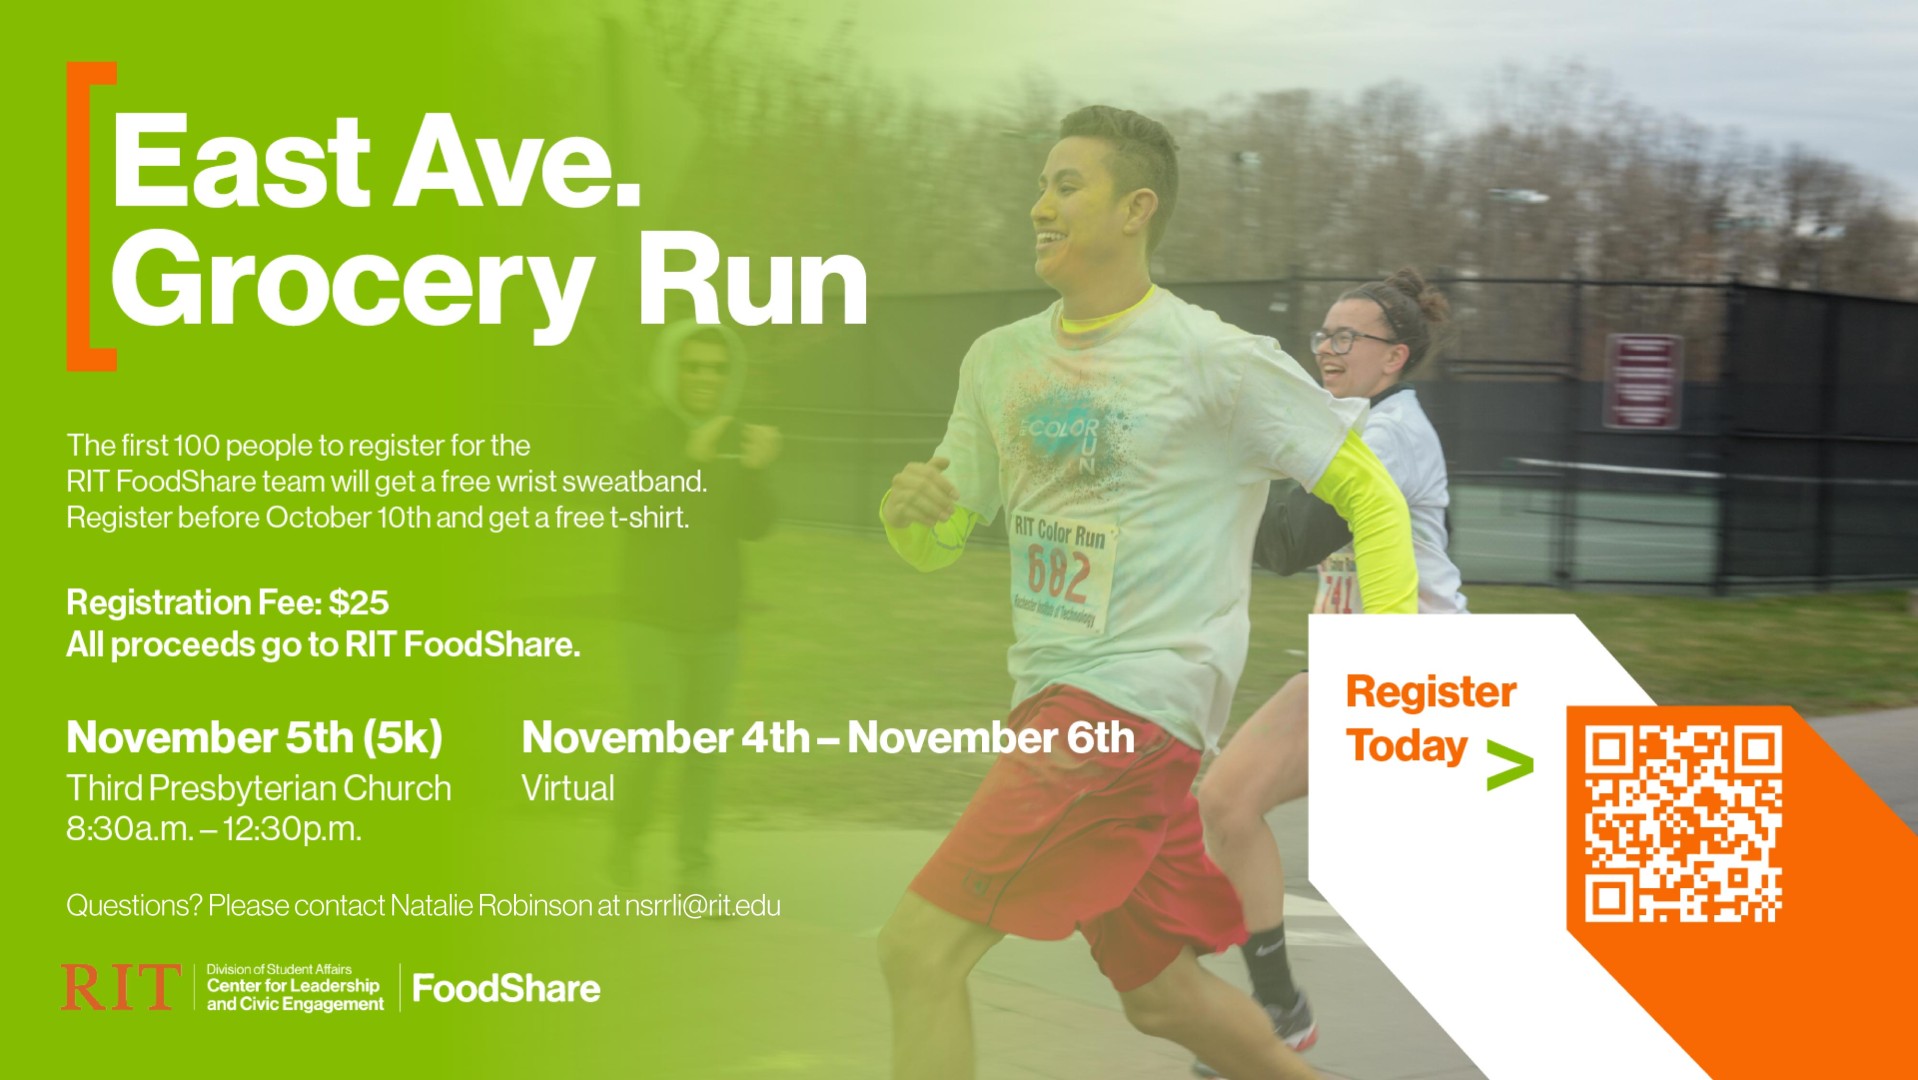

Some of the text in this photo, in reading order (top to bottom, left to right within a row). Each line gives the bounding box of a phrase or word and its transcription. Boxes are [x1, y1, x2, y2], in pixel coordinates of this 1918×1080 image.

[1028, 418, 1100, 438] COLOR
[1015, 515, 1106, 550] RIT Color Run
[1028, 543, 1091, 604] 682
